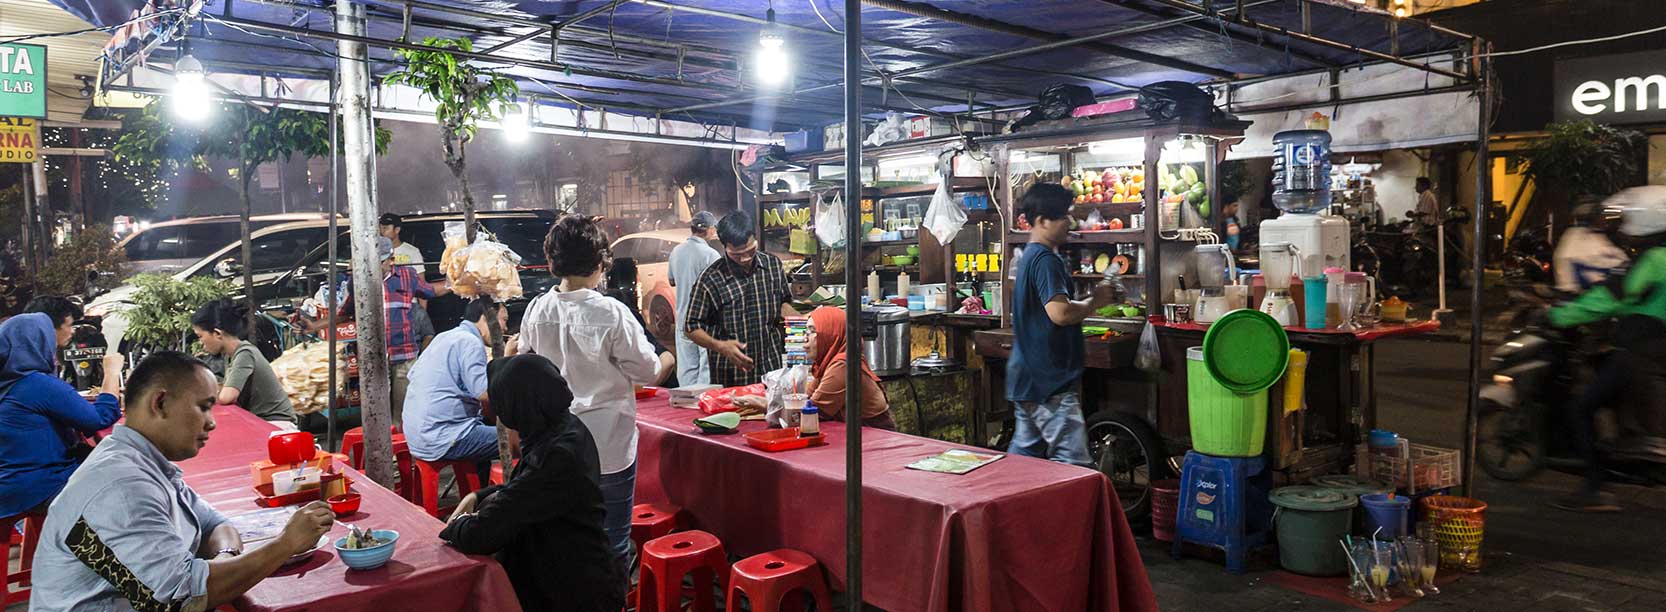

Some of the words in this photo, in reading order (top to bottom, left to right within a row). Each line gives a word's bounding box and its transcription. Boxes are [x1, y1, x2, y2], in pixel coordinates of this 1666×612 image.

[0, 46, 33, 74] TA
[3, 79, 34, 94] LAB
[1572, 74, 1666, 115] em
[0, 150, 33, 159] DIO
